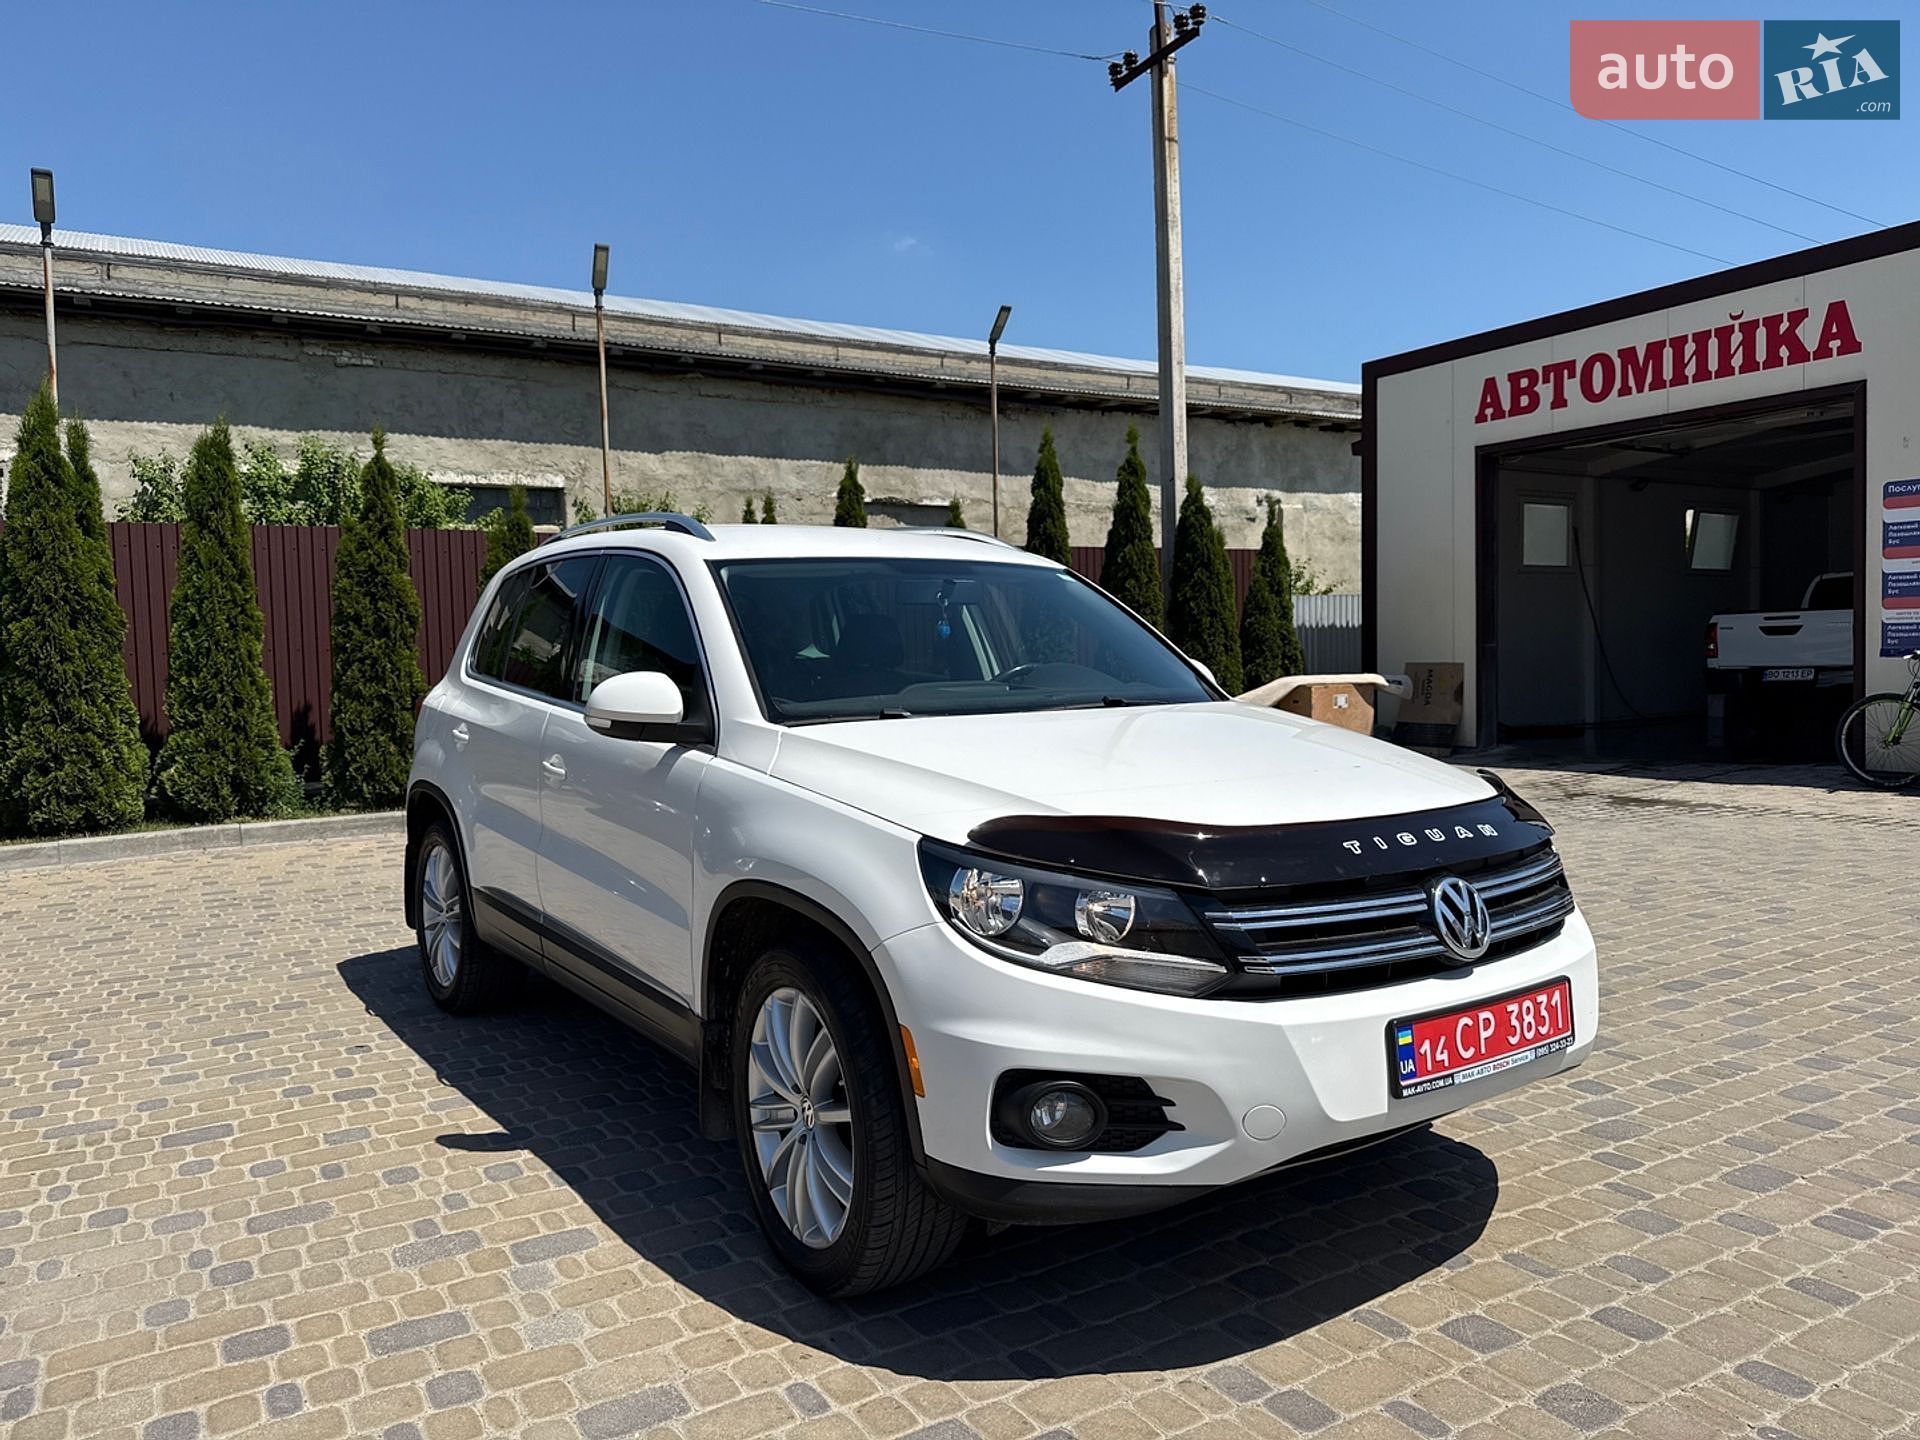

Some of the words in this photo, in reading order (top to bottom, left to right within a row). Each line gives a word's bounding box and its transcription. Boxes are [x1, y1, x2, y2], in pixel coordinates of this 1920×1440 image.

[1474, 300, 1862, 424] АВТОМИЙКА
[1342, 823, 1498, 855] TIGUAN
[1419, 1035, 1449, 1072] 14
[1455, 1010, 1496, 1059] CP
[1506, 989, 1563, 1045] 3831
[1399, 1058, 1415, 1075] UA
